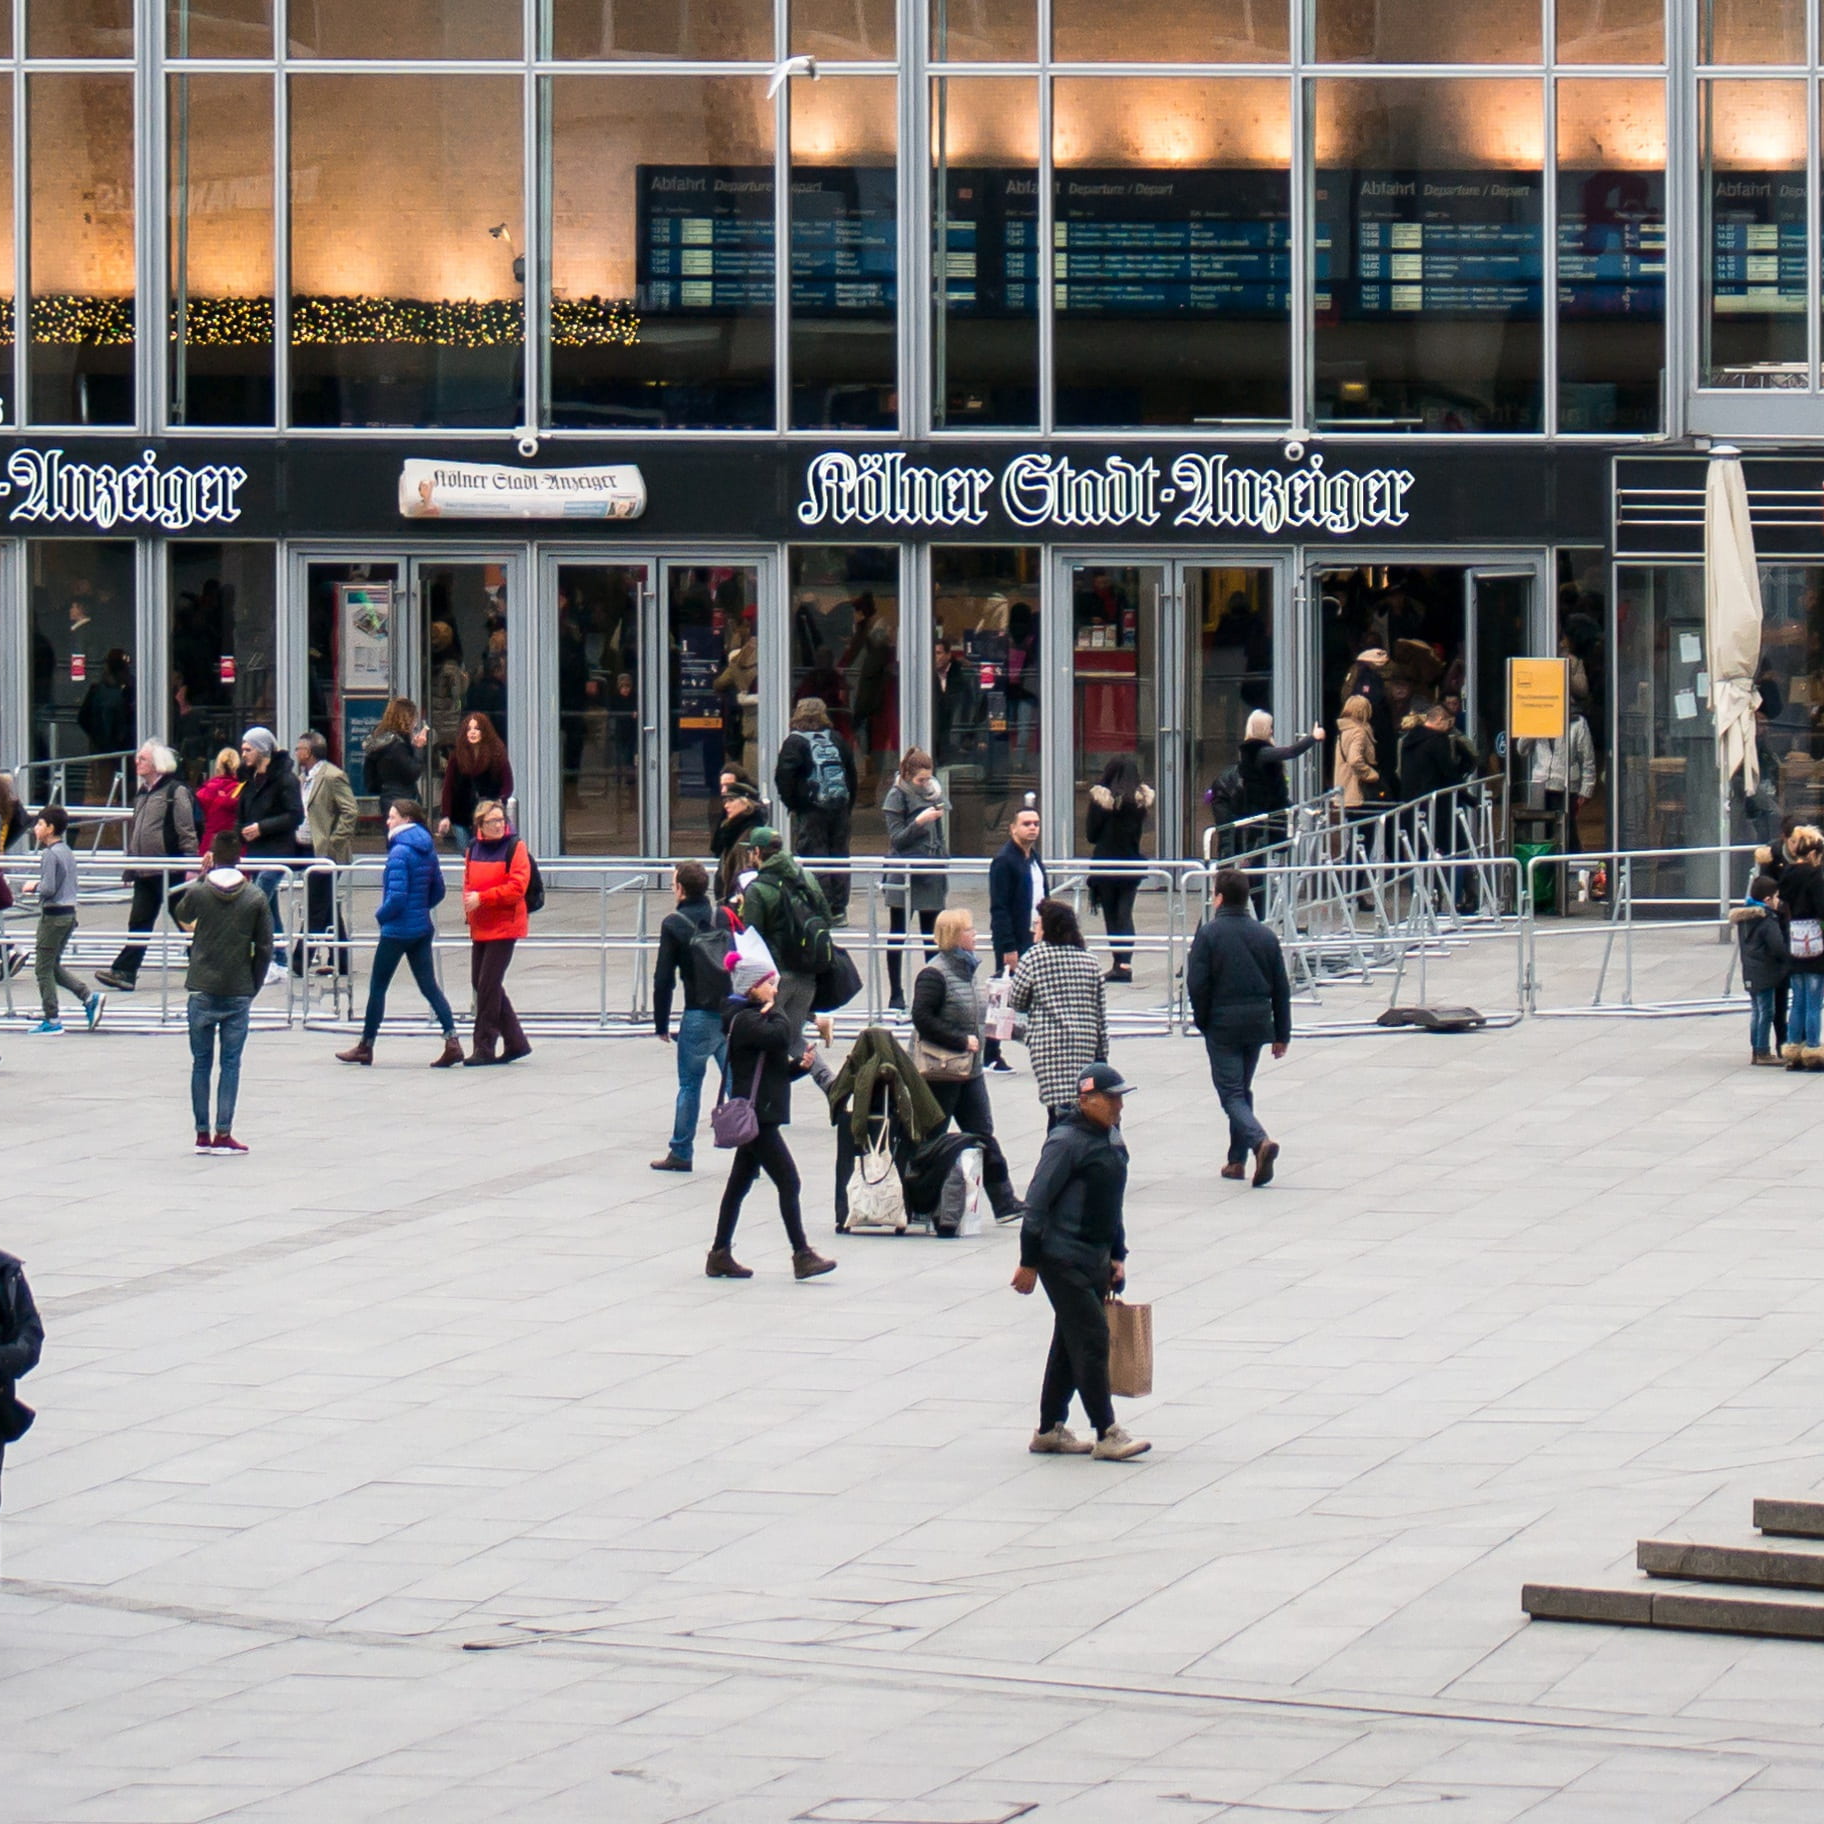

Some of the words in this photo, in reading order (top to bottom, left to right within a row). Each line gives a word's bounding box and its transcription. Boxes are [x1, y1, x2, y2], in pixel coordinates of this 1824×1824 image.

[651, 176, 706, 192] Abfahrt
[1069, 181, 1125, 196] Departure
[1360, 181, 1416, 197] Abfahrt
[1715, 181, 1772, 198] Abfahrt
[433, 469, 489, 491] Kölner
[492, 471, 618, 493] Stadt-Anzeiger
[797, 451, 994, 526] Kölner
[1000, 453, 1416, 533] Stadt-Anzeiger
